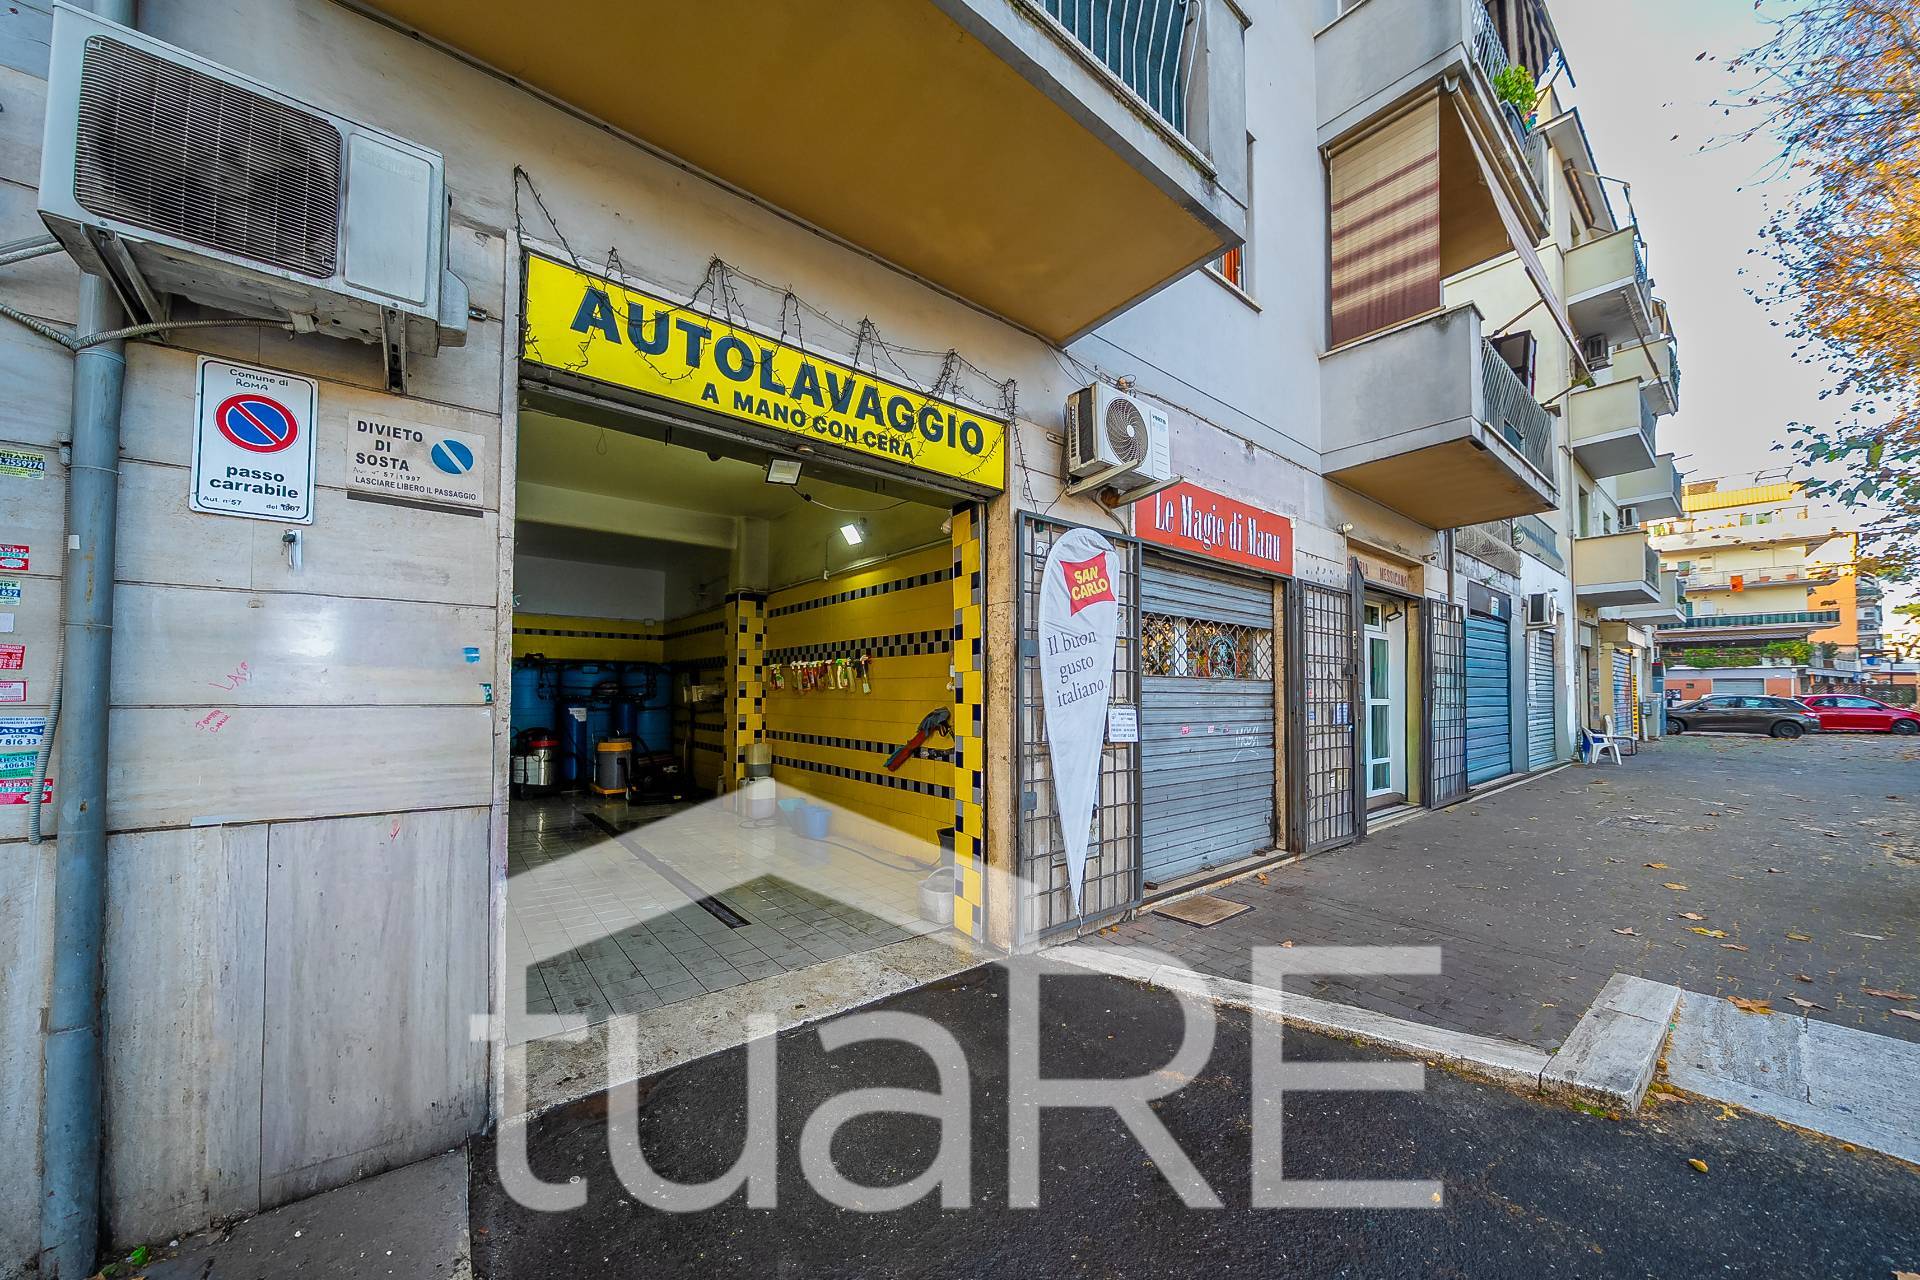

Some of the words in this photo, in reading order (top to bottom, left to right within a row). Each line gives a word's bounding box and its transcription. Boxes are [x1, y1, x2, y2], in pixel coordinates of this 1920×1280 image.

[229, 368, 276, 384] Comune
[278, 377, 289, 387] di
[569, 286, 984, 455] AUTOLAVAGGIO
[235, 378, 269, 391] ROMA
[357, 420, 423, 442] DIVIETO
[701, 382, 719, 404] A
[733, 390, 806, 428] MANO
[813, 415, 858, 444] CON
[863, 429, 914, 460] CERA
[375, 440, 391, 452] DI
[356, 452, 410, 472] SOSTA
[226, 466, 285, 483] passo
[209, 478, 299, 499] carrabile
[355, 476, 396, 489] LASCIARE
[396, 482, 425, 493] LIBERO
[426, 487, 433, 495] IL
[434, 488, 476, 501] PASSAGGIO
[1155, 491, 1174, 533] Le
[1180, 494, 1225, 550] Magie
[1229, 511, 1243, 552] di
[1247, 517, 1280, 562] Manu
[1074, 565, 1099, 585] SAN
[1071, 578, 1108, 601] CARLO
[1047, 633, 1058, 656] Il
[1061, 630, 1097, 652] buon
[1059, 655, 1094, 684] gusto
